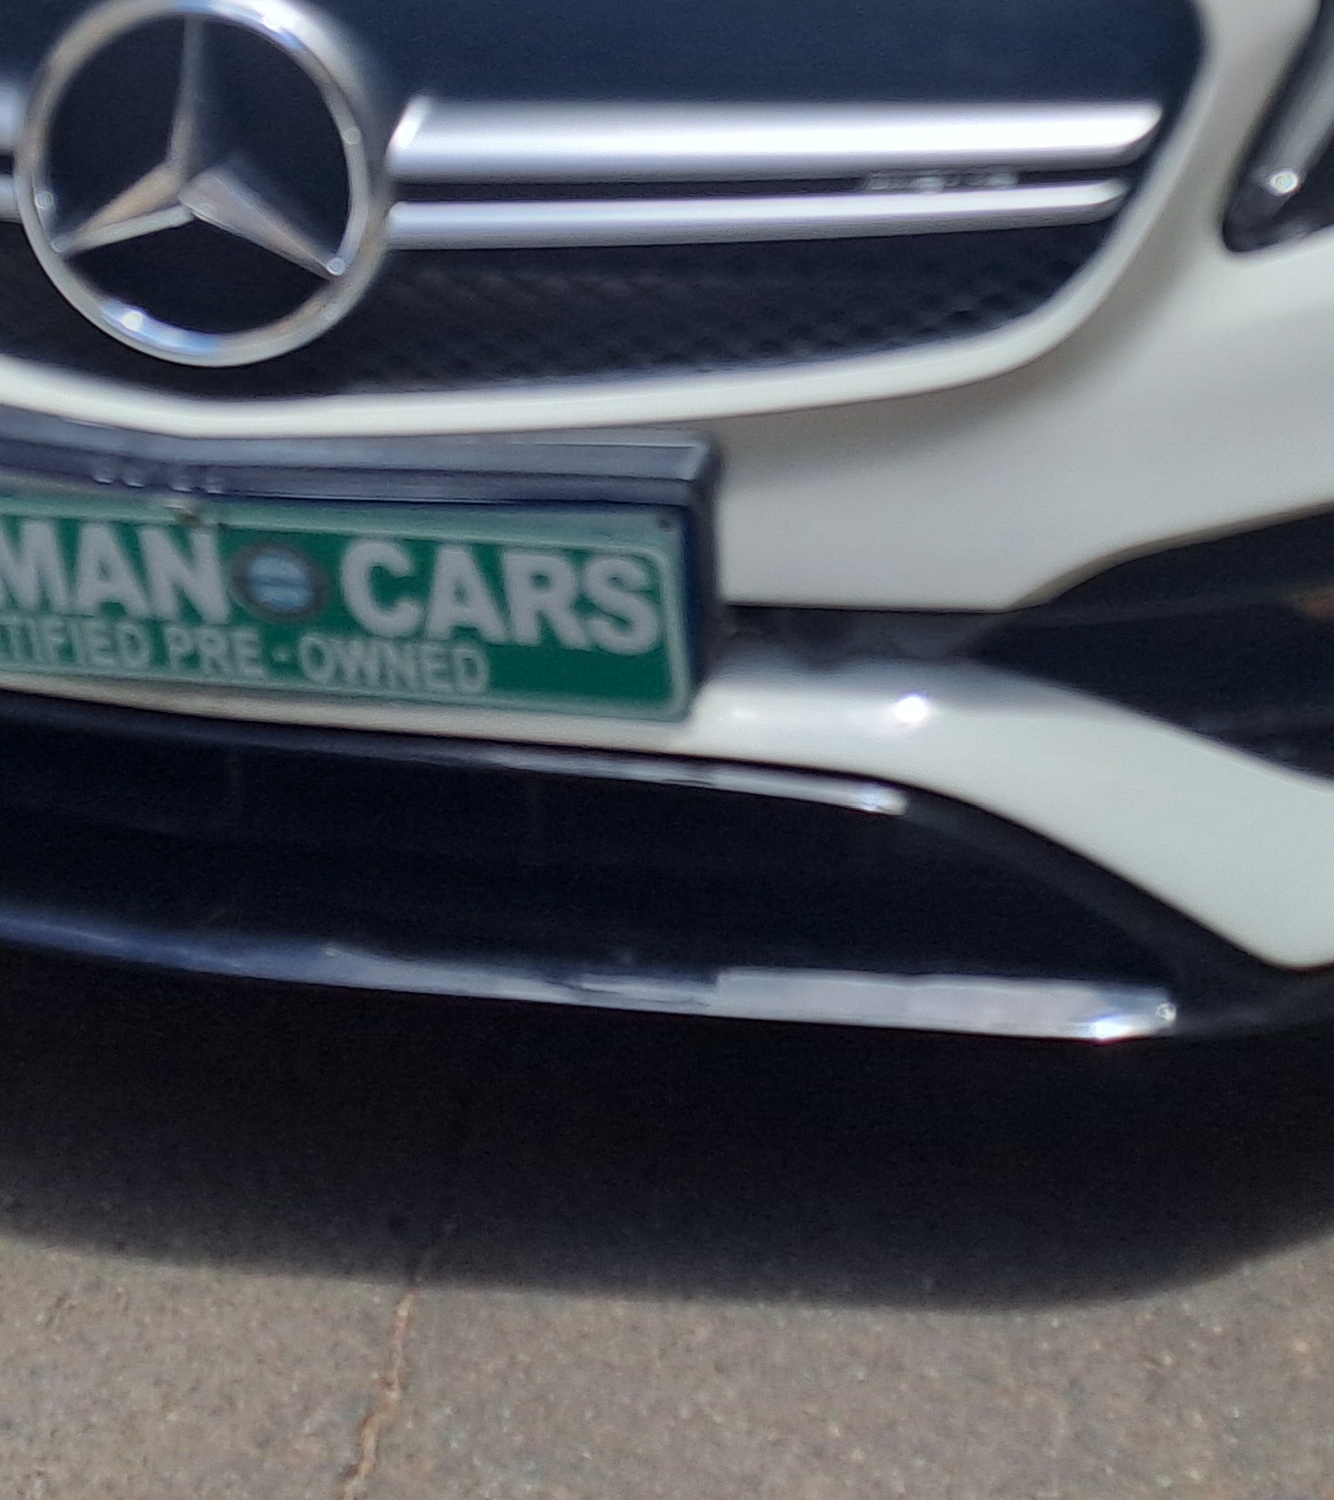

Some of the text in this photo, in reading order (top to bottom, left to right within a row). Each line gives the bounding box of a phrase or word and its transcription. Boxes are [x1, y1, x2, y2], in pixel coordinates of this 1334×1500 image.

[342, 536, 658, 654] CARS
[164, 624, 264, 676] PRE
[299, 632, 489, 695] OWNED
